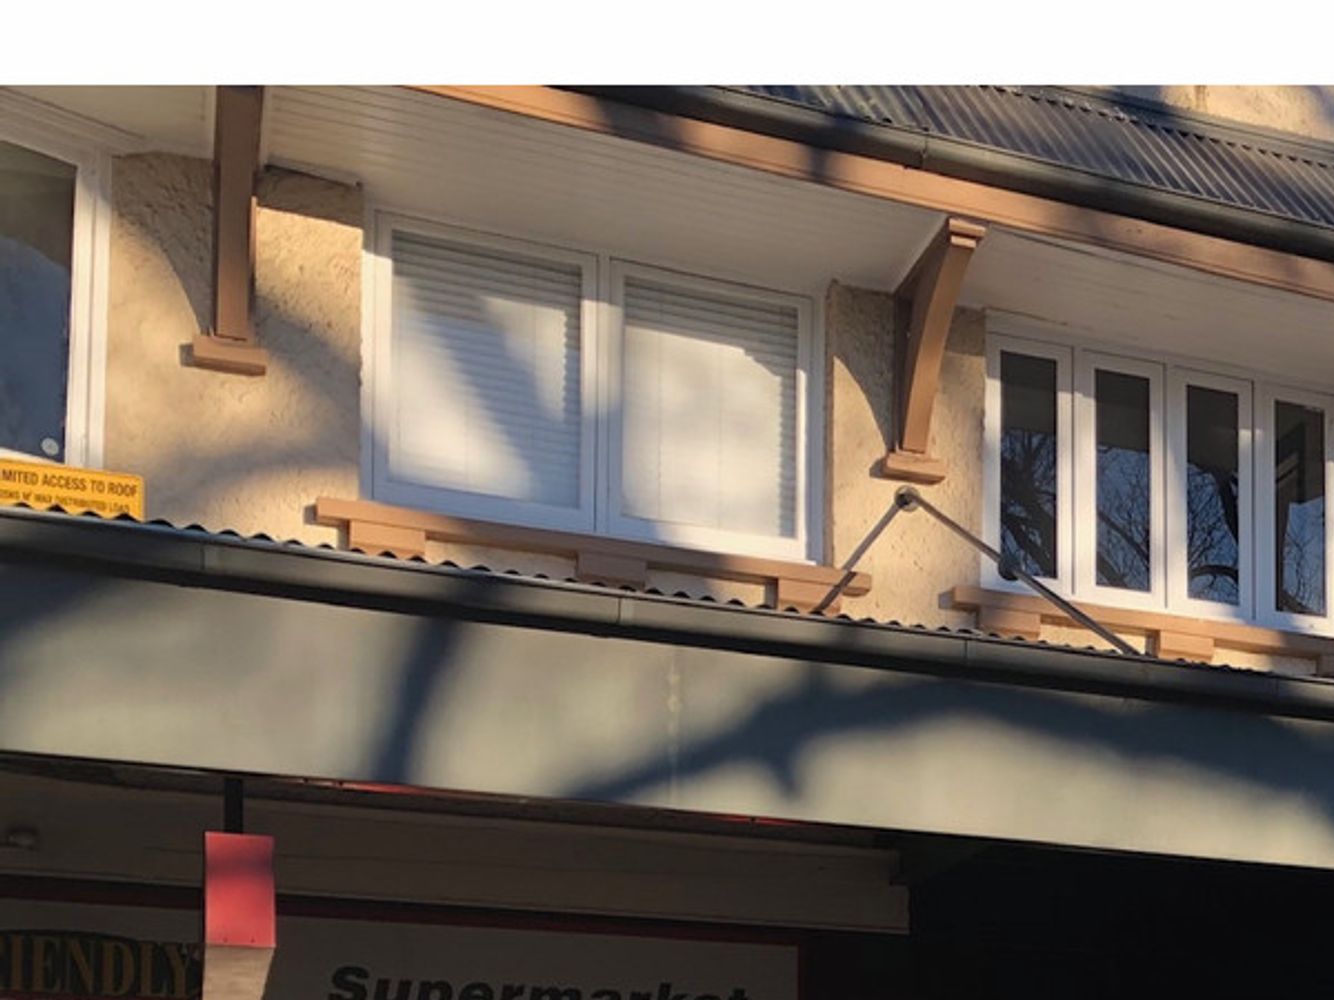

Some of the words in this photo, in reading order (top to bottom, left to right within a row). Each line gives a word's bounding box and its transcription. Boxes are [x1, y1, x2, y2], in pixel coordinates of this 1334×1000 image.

[42, 473, 87, 491] ACCESS
[90, 480, 105, 493] TO
[107, 482, 137, 497] ROOF
[0, 933, 192, 998] IENDLY
